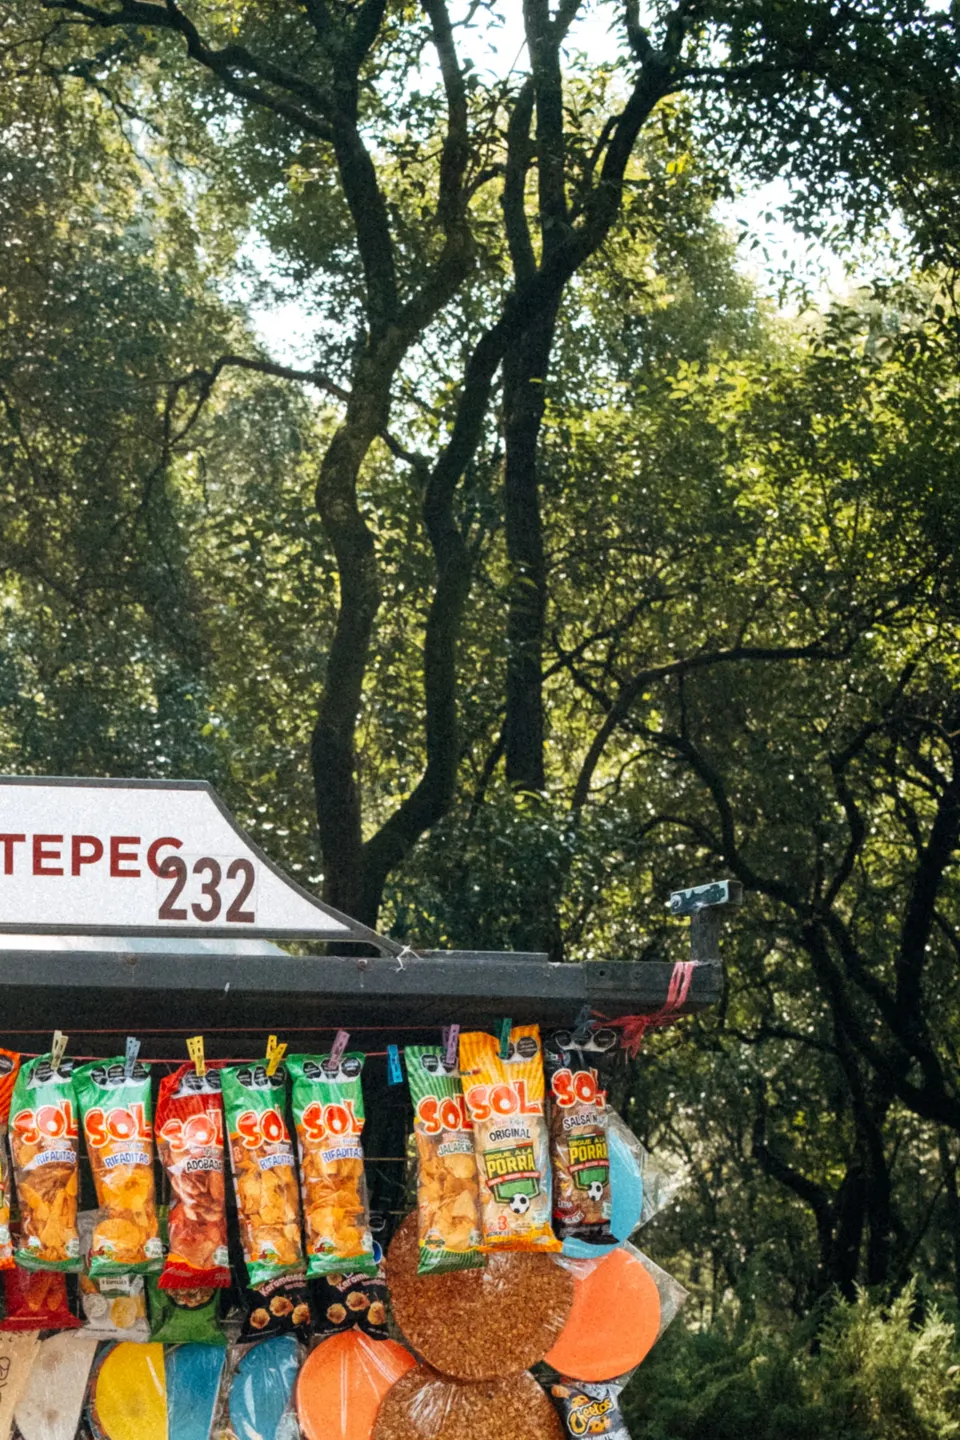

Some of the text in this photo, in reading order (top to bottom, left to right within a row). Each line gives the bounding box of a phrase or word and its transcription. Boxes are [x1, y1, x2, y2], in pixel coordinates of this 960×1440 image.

[158, 856, 256, 923] 232
[301, 1099, 364, 1142] SOL
[416, 1093, 474, 1135] SOL
[465, 1080, 544, 1122] SOL
[11, 1100, 79, 1146] SOL
[84, 1101, 153, 1149] SOL
[160, 1108, 224, 1153] SOL
[489, 1128, 531, 1141] ORIGINAL
[36, 1149, 77, 1165] RIFADITAS
[104, 1151, 150, 1168] RIFADITAS
[486, 1155, 536, 1177] PORRA
[498, 1216, 508, 1231] 3
[568, 1397, 615, 1435] Cheetos
